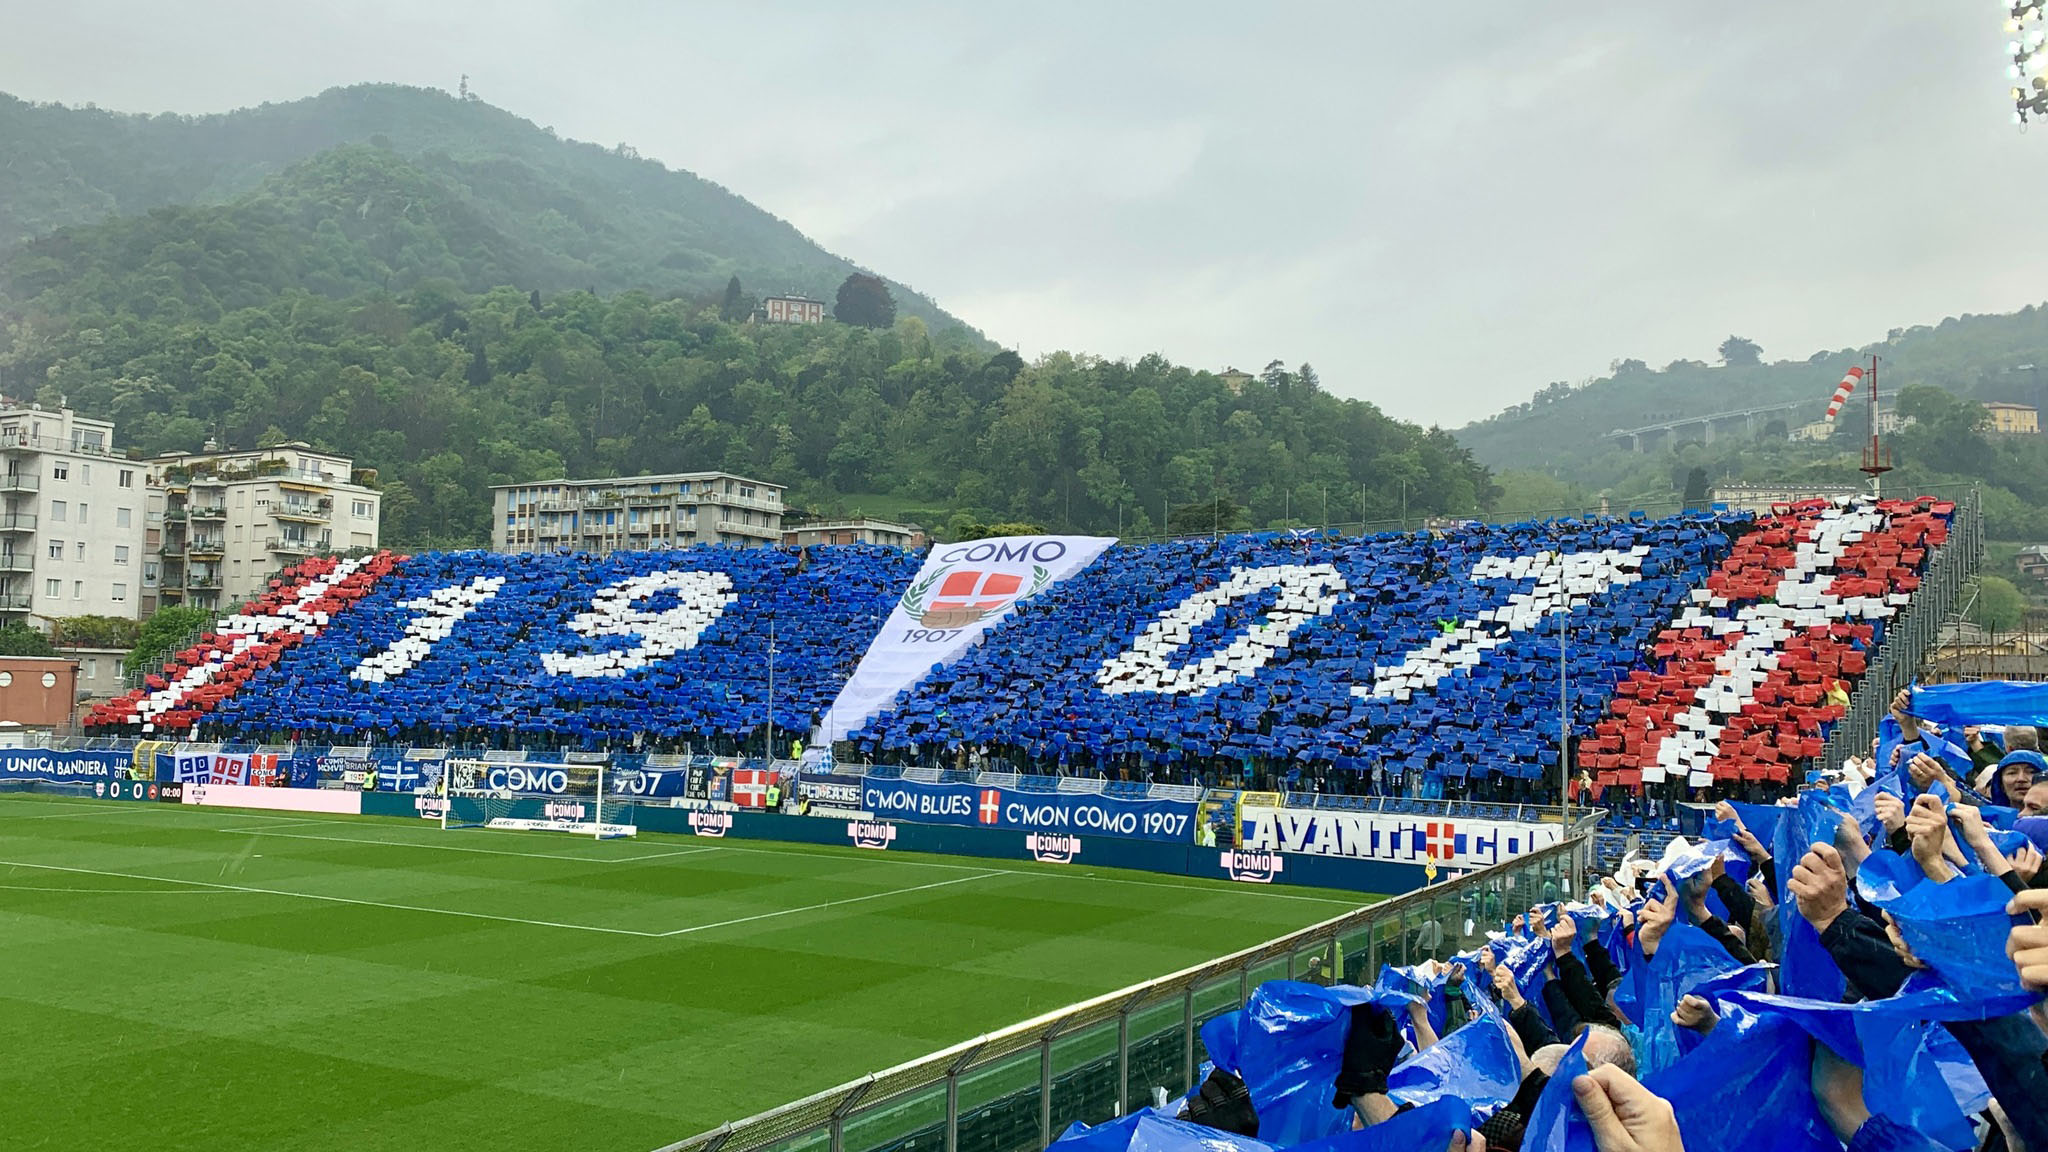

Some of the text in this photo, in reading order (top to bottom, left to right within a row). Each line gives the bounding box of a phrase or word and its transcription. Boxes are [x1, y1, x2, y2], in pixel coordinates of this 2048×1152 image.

[940, 540, 1067, 563] COMO
[902, 629, 964, 644] 1907
[6, 757, 108, 776] UNICA BANDIERA
[110, 781, 120, 798] 0
[133, 782, 143, 799] 0
[489, 768, 568, 794] COMO
[161, 787, 181, 798] 00:00
[422, 798, 444, 811] COMO
[553, 804, 577, 818] COMO
[866, 788, 972, 816] C'MON BLUES
[697, 812, 723, 828] COMO
[1006, 802, 1189, 836] C'MON COMO 1907
[858, 823, 886, 839] COMO
[1037, 834, 1070, 852] COMO
[1233, 854, 1271, 872] COMO
